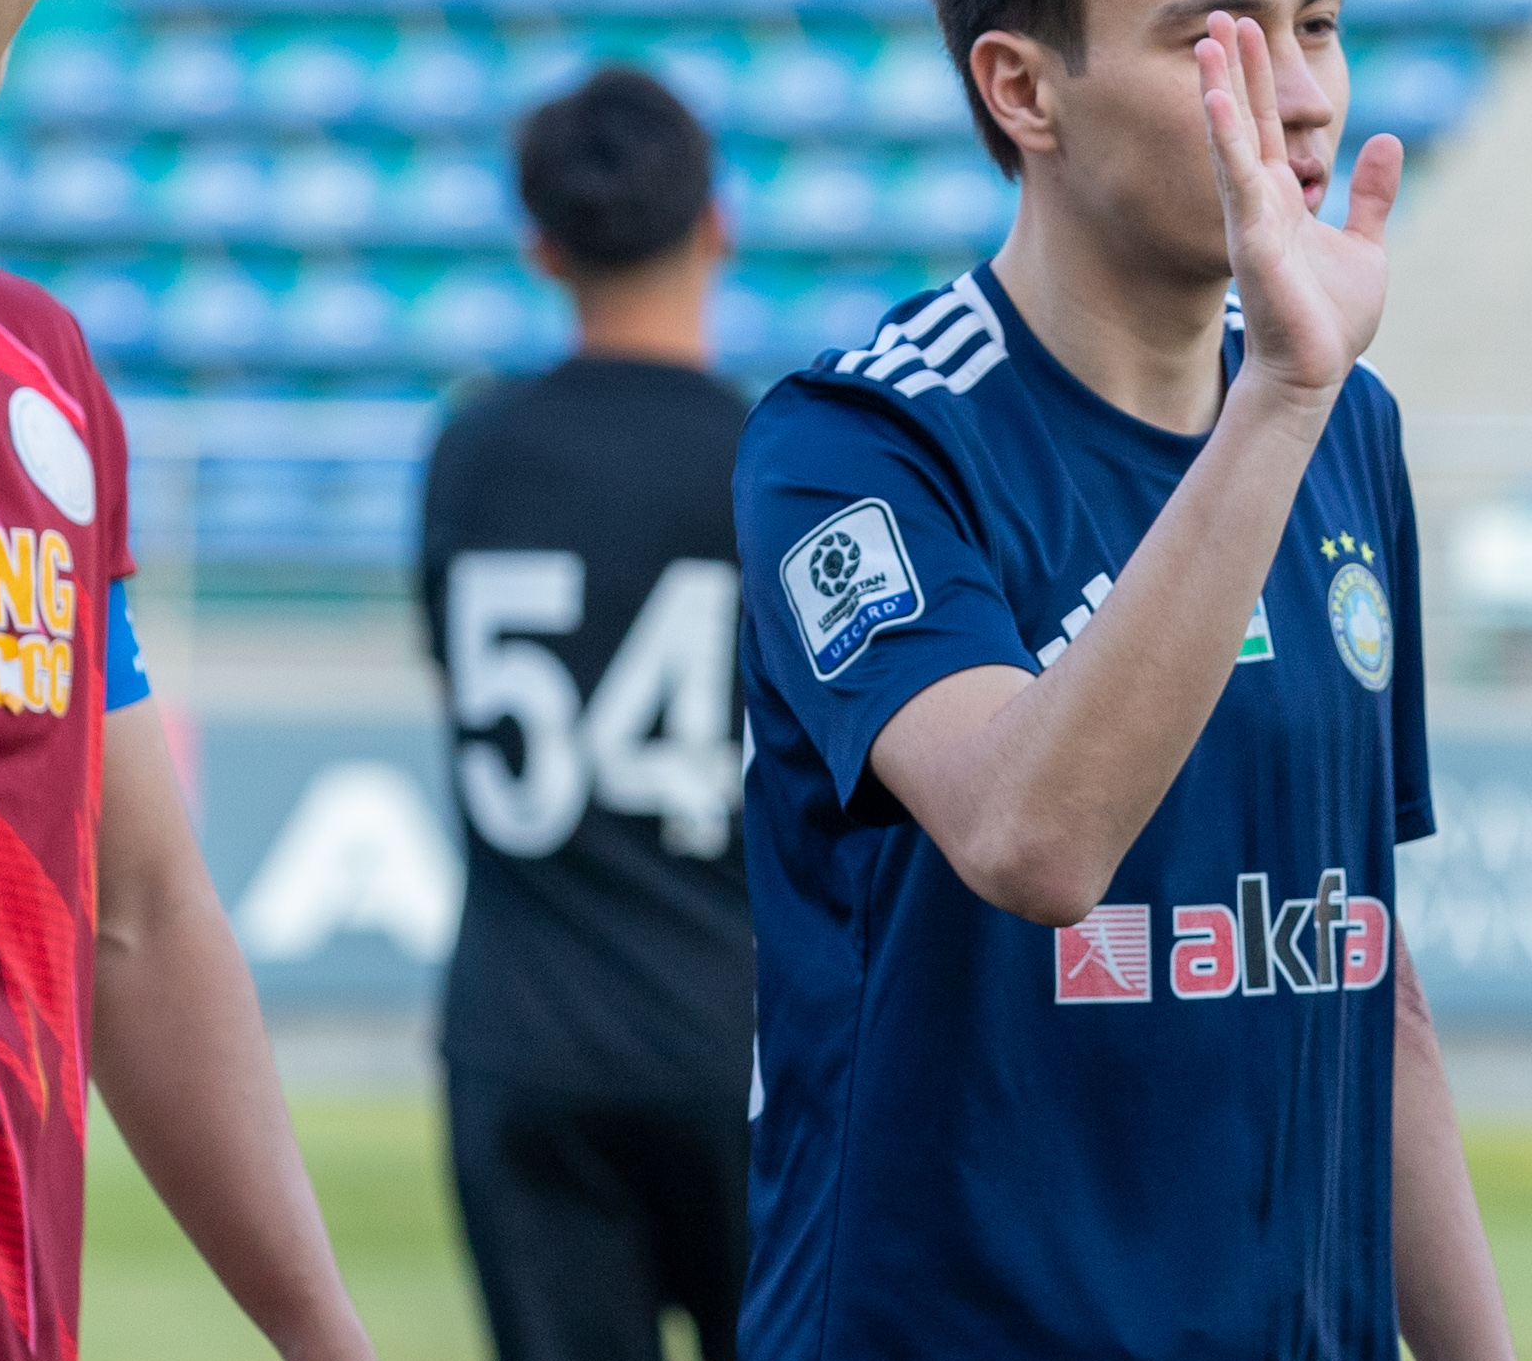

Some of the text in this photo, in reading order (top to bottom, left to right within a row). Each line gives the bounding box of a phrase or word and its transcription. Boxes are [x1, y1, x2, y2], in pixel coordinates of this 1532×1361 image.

[830, 598, 899, 659] UZCARD
[446, 548, 743, 860] 54
[1170, 868, 1390, 1000] akfa
